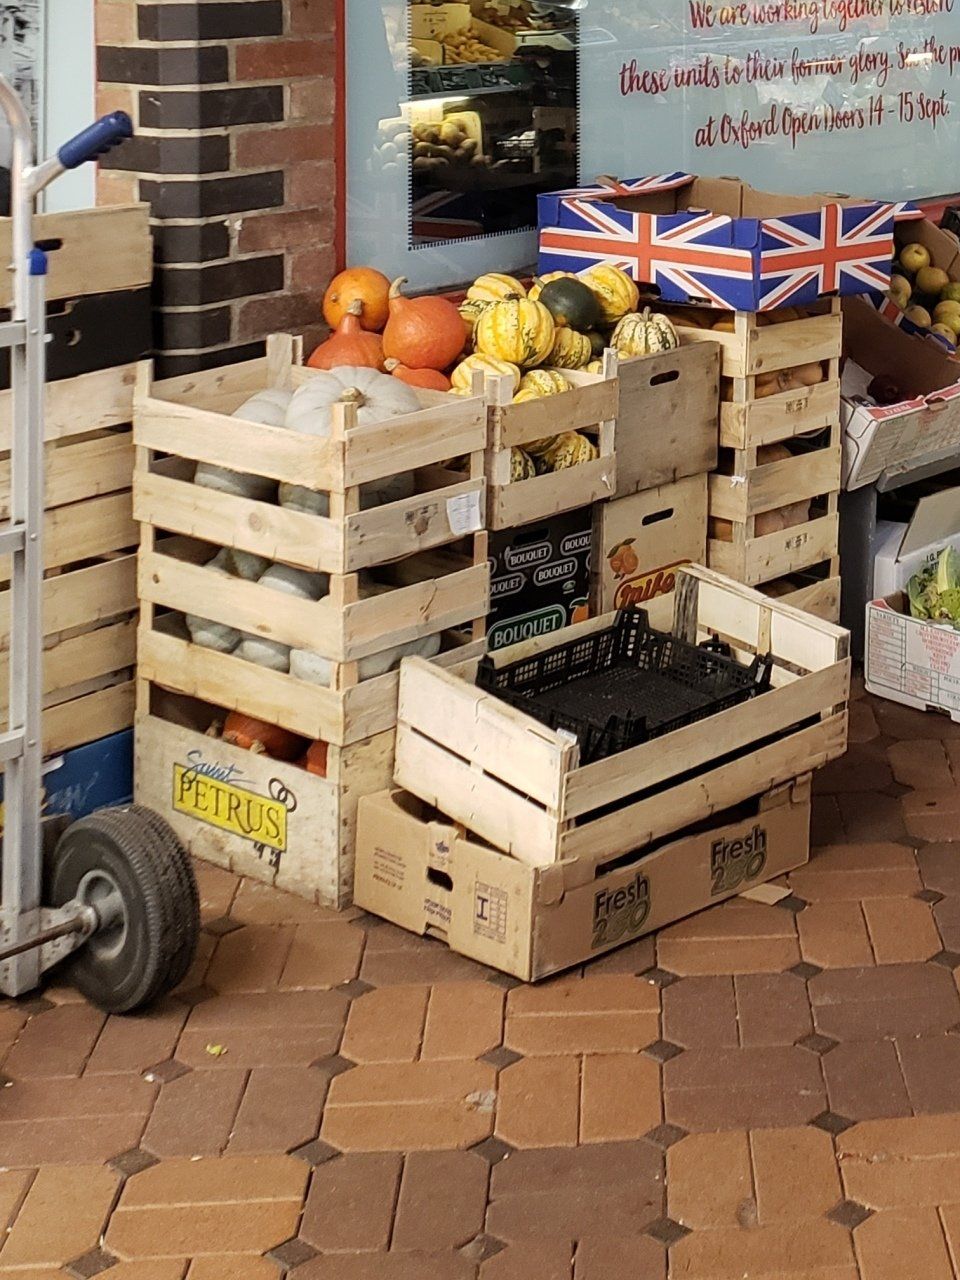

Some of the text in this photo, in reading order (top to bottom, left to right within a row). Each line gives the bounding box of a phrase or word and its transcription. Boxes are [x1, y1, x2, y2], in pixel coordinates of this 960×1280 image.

[689, 0, 714, 29] We
[715, 3, 750, 26] are
[619, 60, 671, 96] these
[673, 63, 721, 89] units
[723, 59, 743, 86] to
[744, 52, 788, 84] their
[790, 47, 848, 79] former
[848, 42, 895, 88] glory.
[695, 116, 717, 148] at
[720, 103, 779, 150] Oxford
[781, 106, 823, 150] Open
[824, 106, 865, 133] Doors
[867, 93, 884, 123] 14
[897, 92, 914, 123] 15
[916, 88, 951, 130] Sept.
[510, 533, 592, 566] BOUQUET BOUQU
[538, 561, 574, 581] BOUQUET
[493, 613, 560, 648] BOUQUET
[177, 776, 280, 839] PETRUS
[711, 824, 768, 867] Fresh
[594, 873, 649, 918] Fresh
